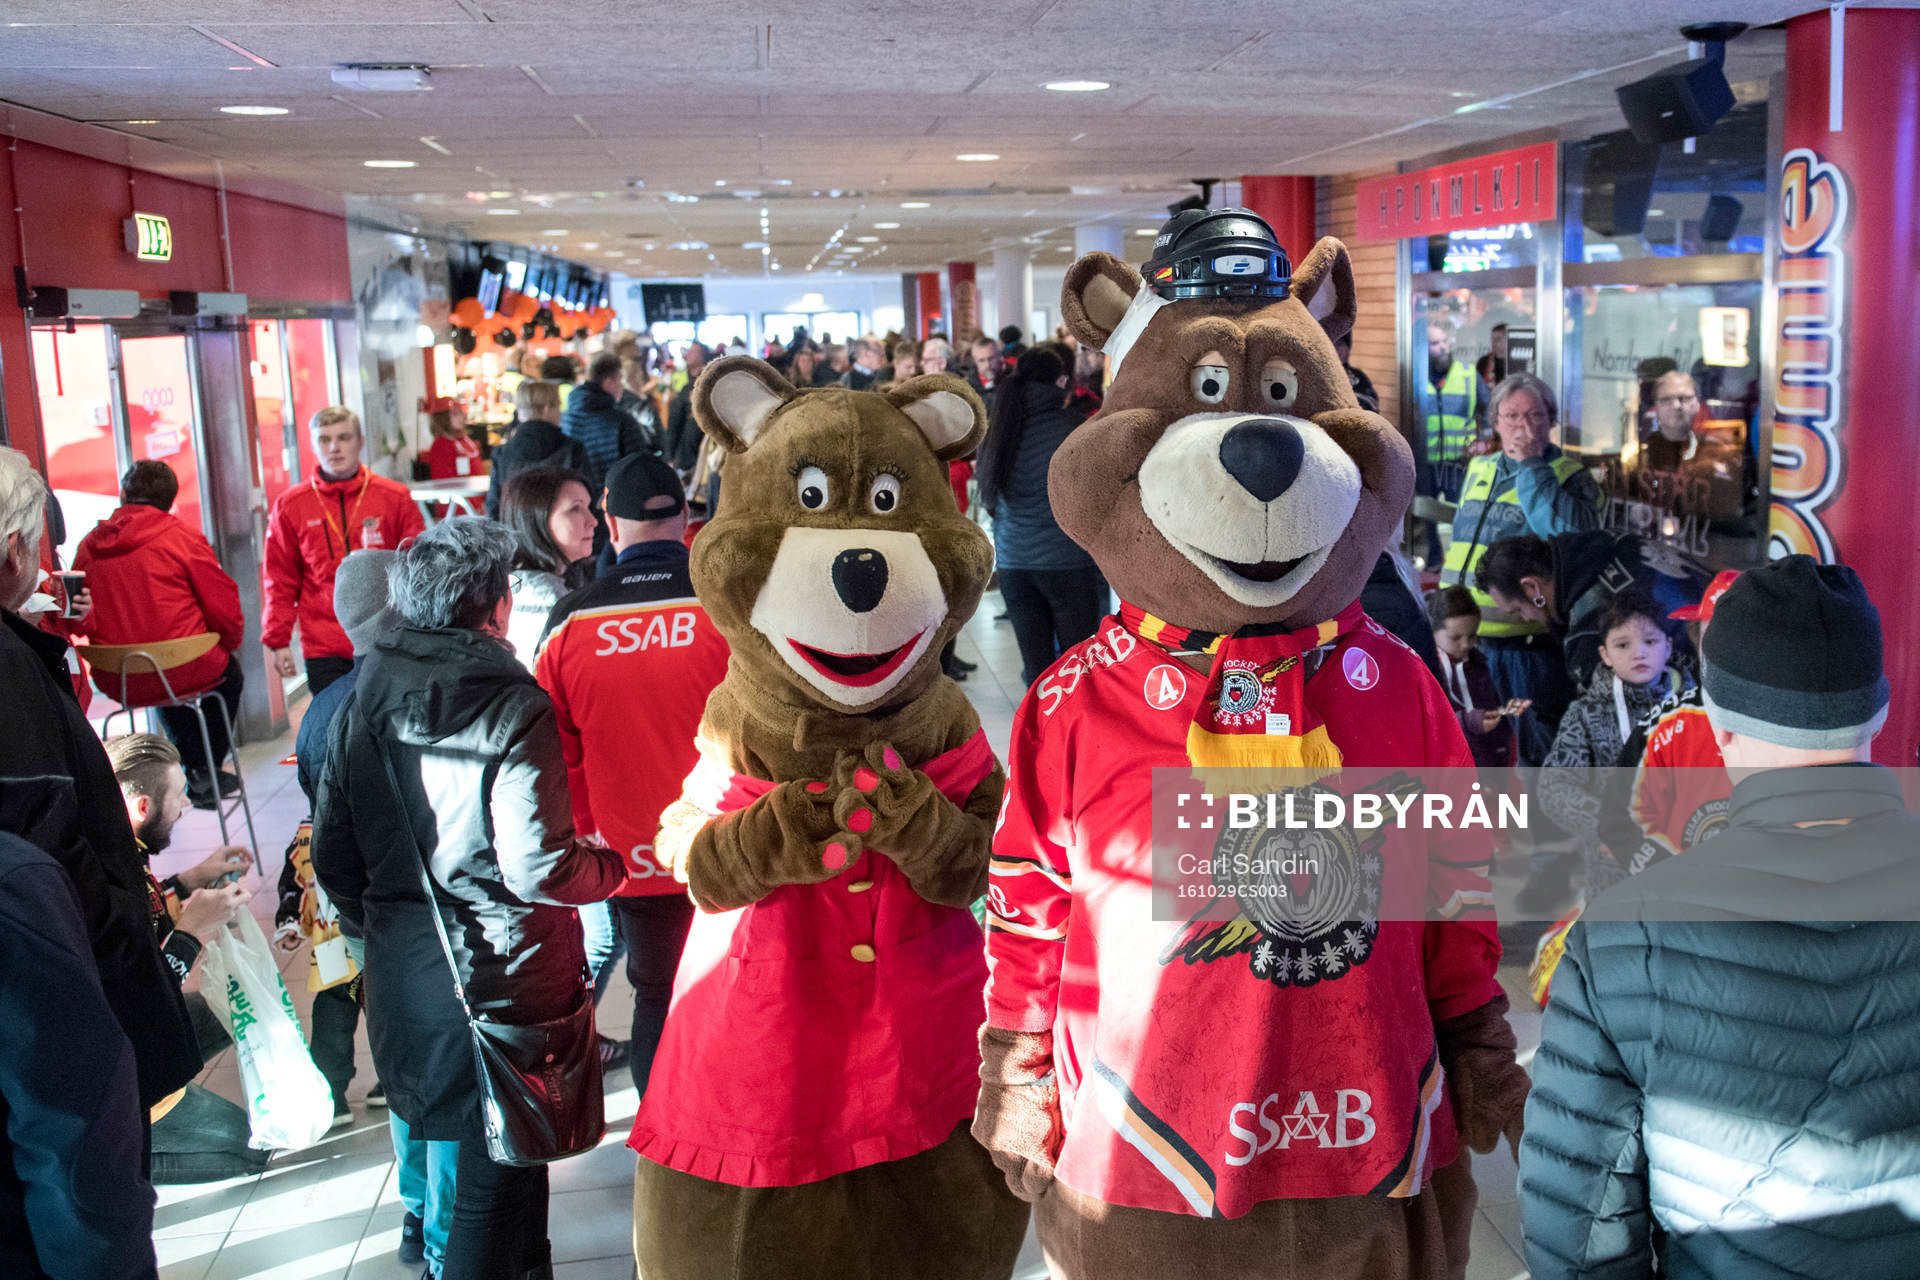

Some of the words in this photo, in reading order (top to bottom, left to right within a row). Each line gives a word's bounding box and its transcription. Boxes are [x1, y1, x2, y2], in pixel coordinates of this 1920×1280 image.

[595, 612, 696, 656] SSAB
[1037, 625, 1136, 716] SSAB
[1225, 1088, 1377, 1167] SSAB
